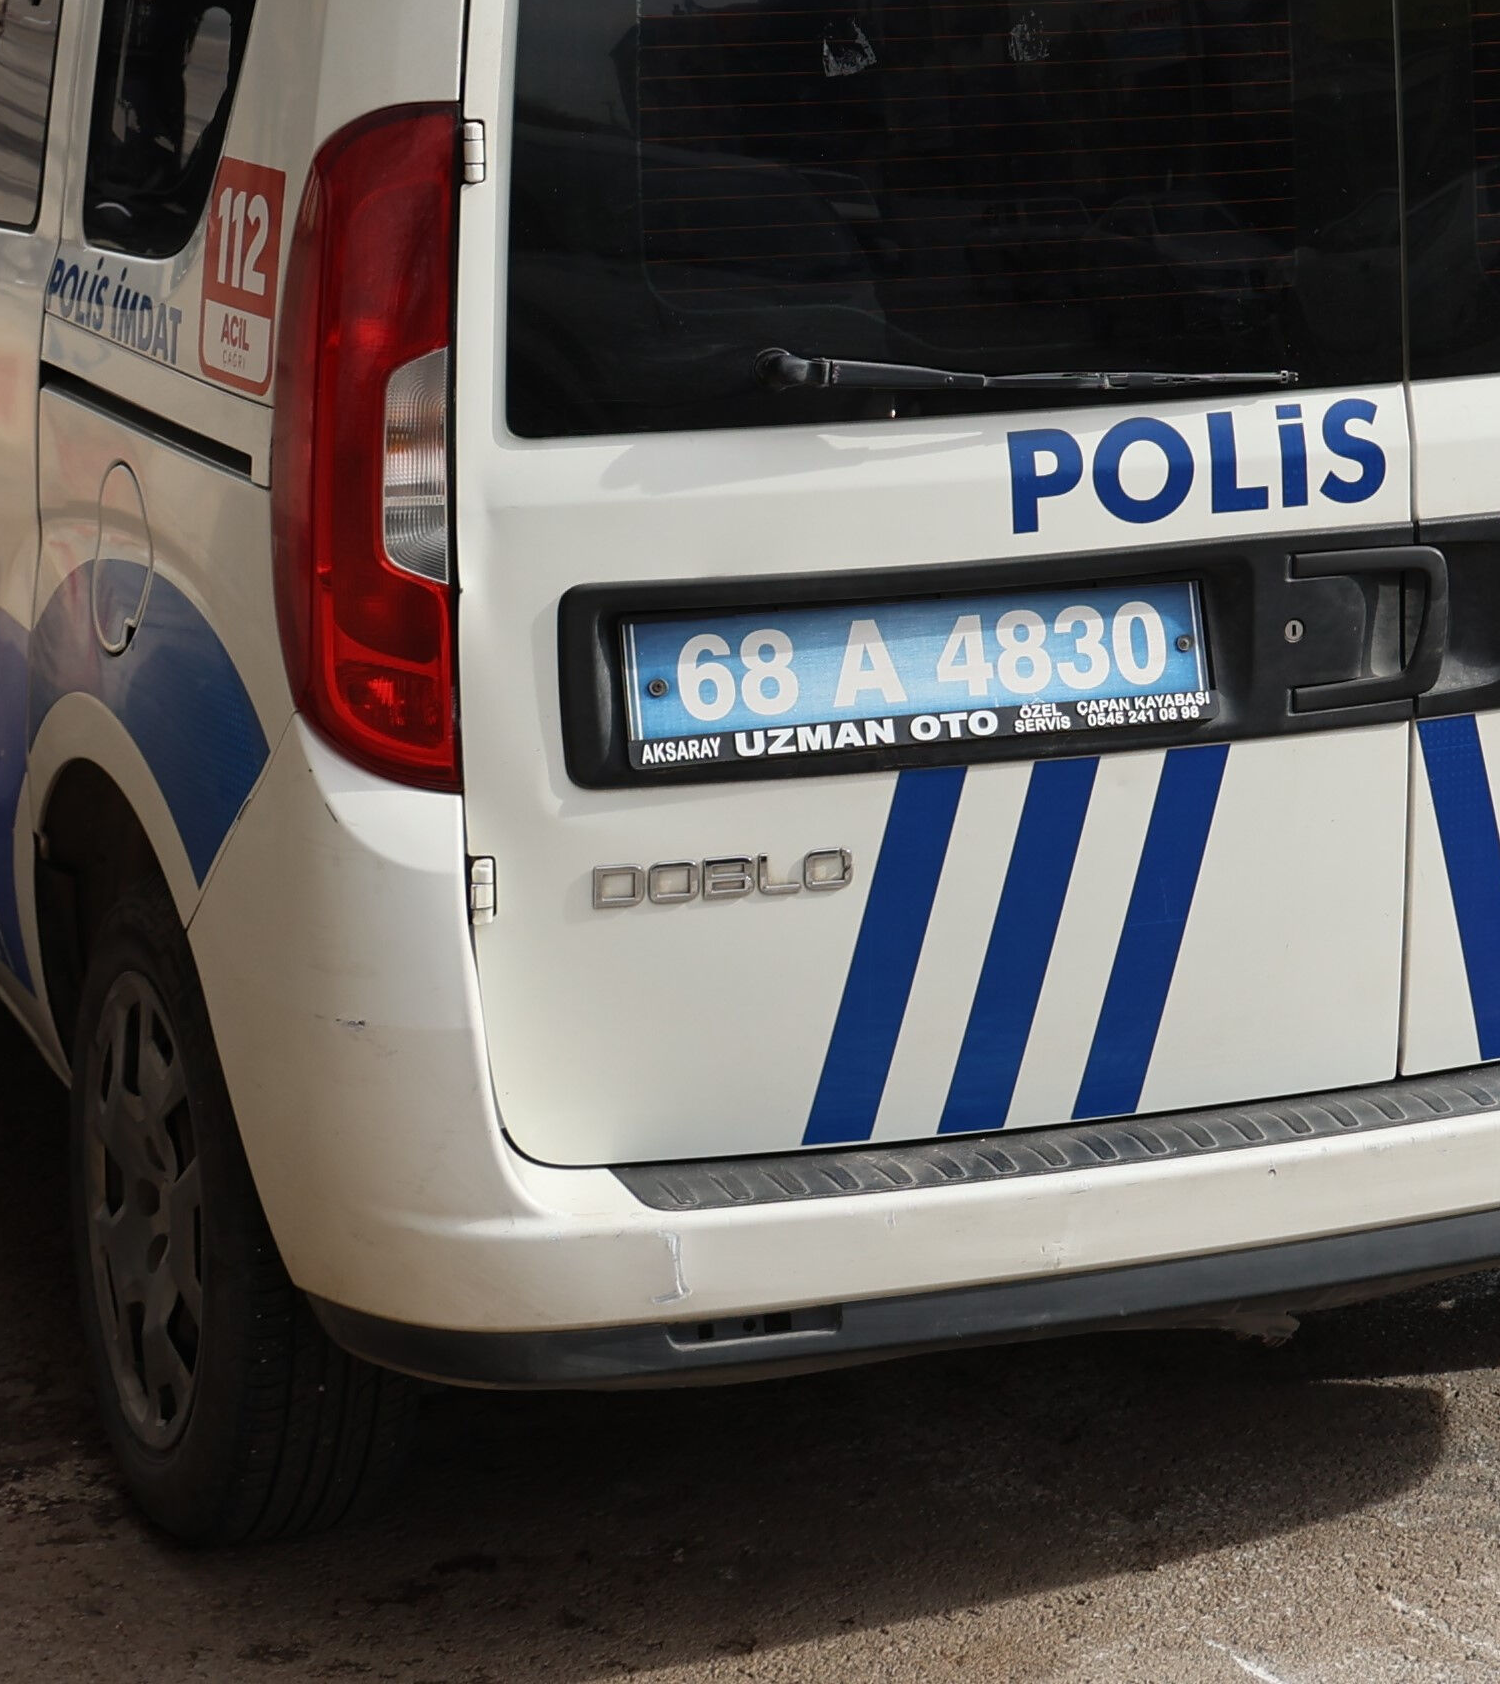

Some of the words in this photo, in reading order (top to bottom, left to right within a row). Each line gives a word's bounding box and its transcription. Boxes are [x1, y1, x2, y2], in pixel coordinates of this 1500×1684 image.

[216, 186, 270, 297] 112
[676, 628, 799, 721] 68
[832, 618, 907, 709] A
[935, 600, 1168, 698] 4830
[1019, 703, 1063, 719] ÖZEL
[1076, 698, 1132, 716] ÇAPAN
[1134, 690, 1211, 710] KAYABAŞI
[1087, 711, 1125, 728] 0545
[1128, 709, 1156, 725] 241
[1161, 707, 1179, 722] 08
[1181, 705, 1200, 720] 98
[640, 735, 722, 765] AKSARAY
[733, 717, 896, 758] UZMAN
[908, 709, 999, 742] OTO
[592, 846, 853, 910] DOBLO
